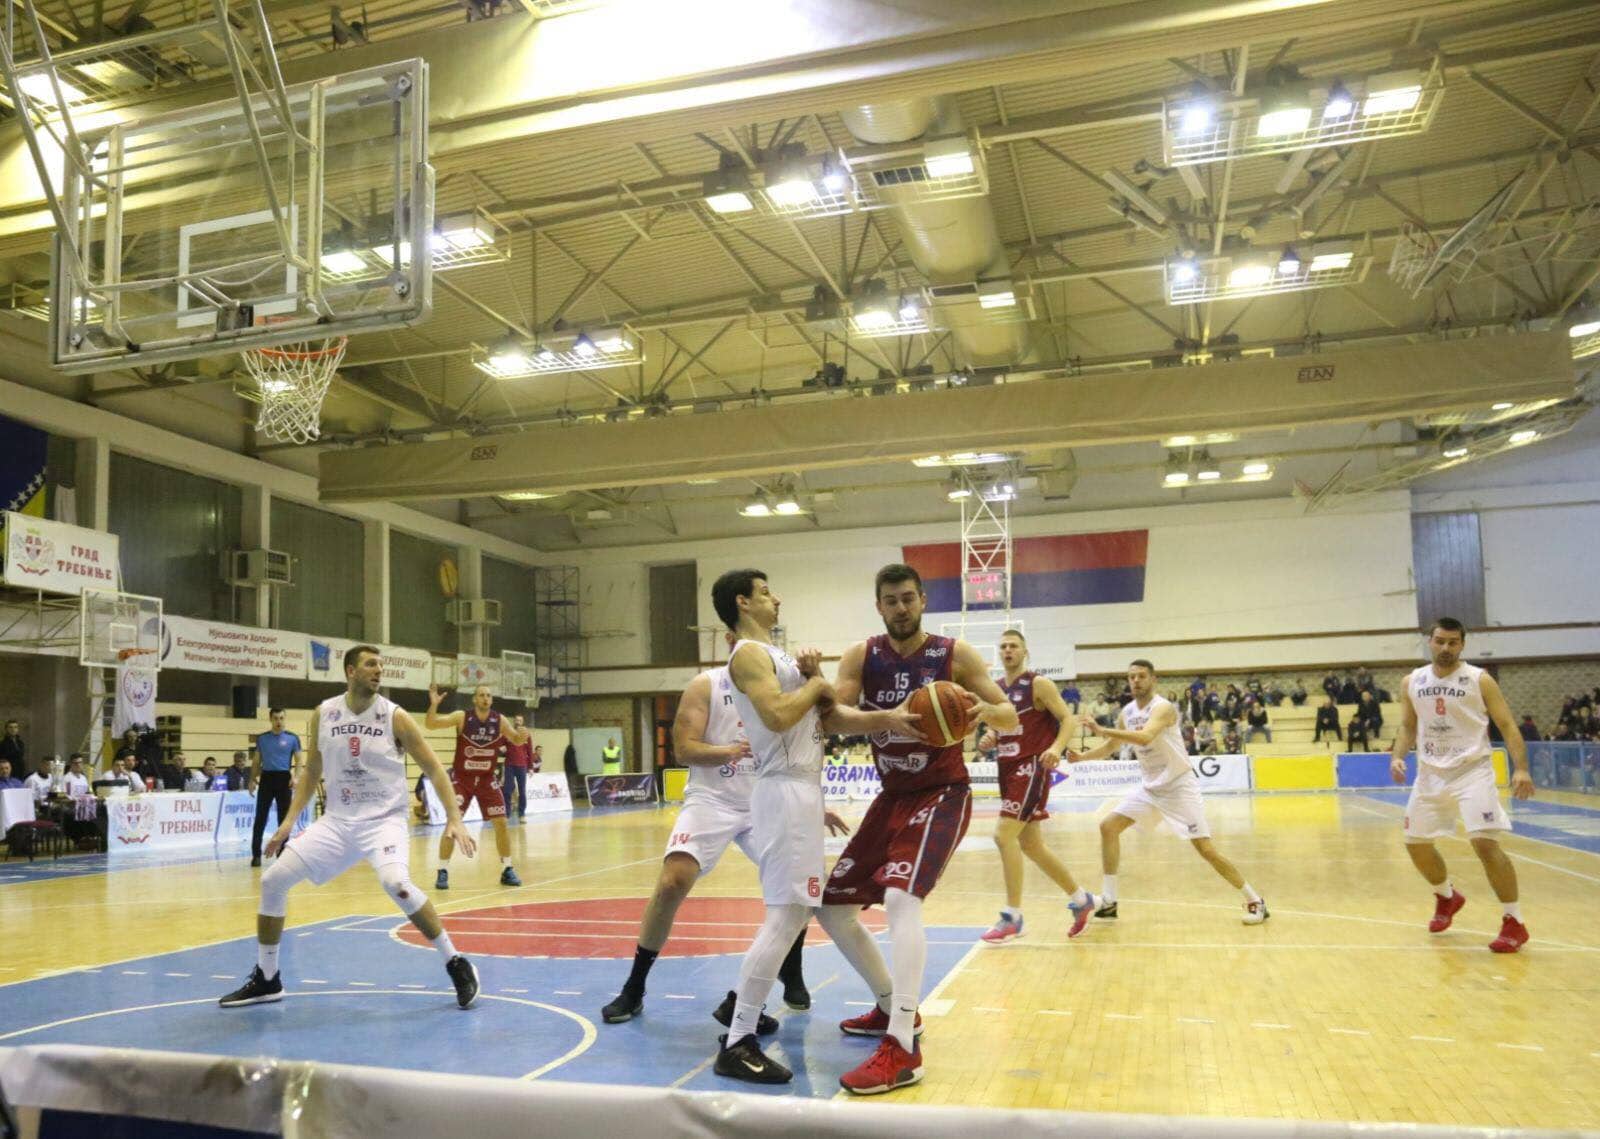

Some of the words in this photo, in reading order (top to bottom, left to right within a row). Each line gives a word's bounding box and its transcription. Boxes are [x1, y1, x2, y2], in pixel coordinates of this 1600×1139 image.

[71, 545, 99, 561] ГРАД
[57, 560, 113, 580] ТРЕБИЊЕ
[894, 672, 910, 689] 15
[1418, 686, 1466, 698] ЛЕОТАР
[1435, 698, 1446, 716] 8
[331, 724, 383, 737] ЛЕОТАР
[349, 736, 360, 757] 9
[174, 799, 202, 813] ГРАД
[160, 819, 213, 835] ТРЕБИЊЕ
[808, 877, 820, 897] 6
